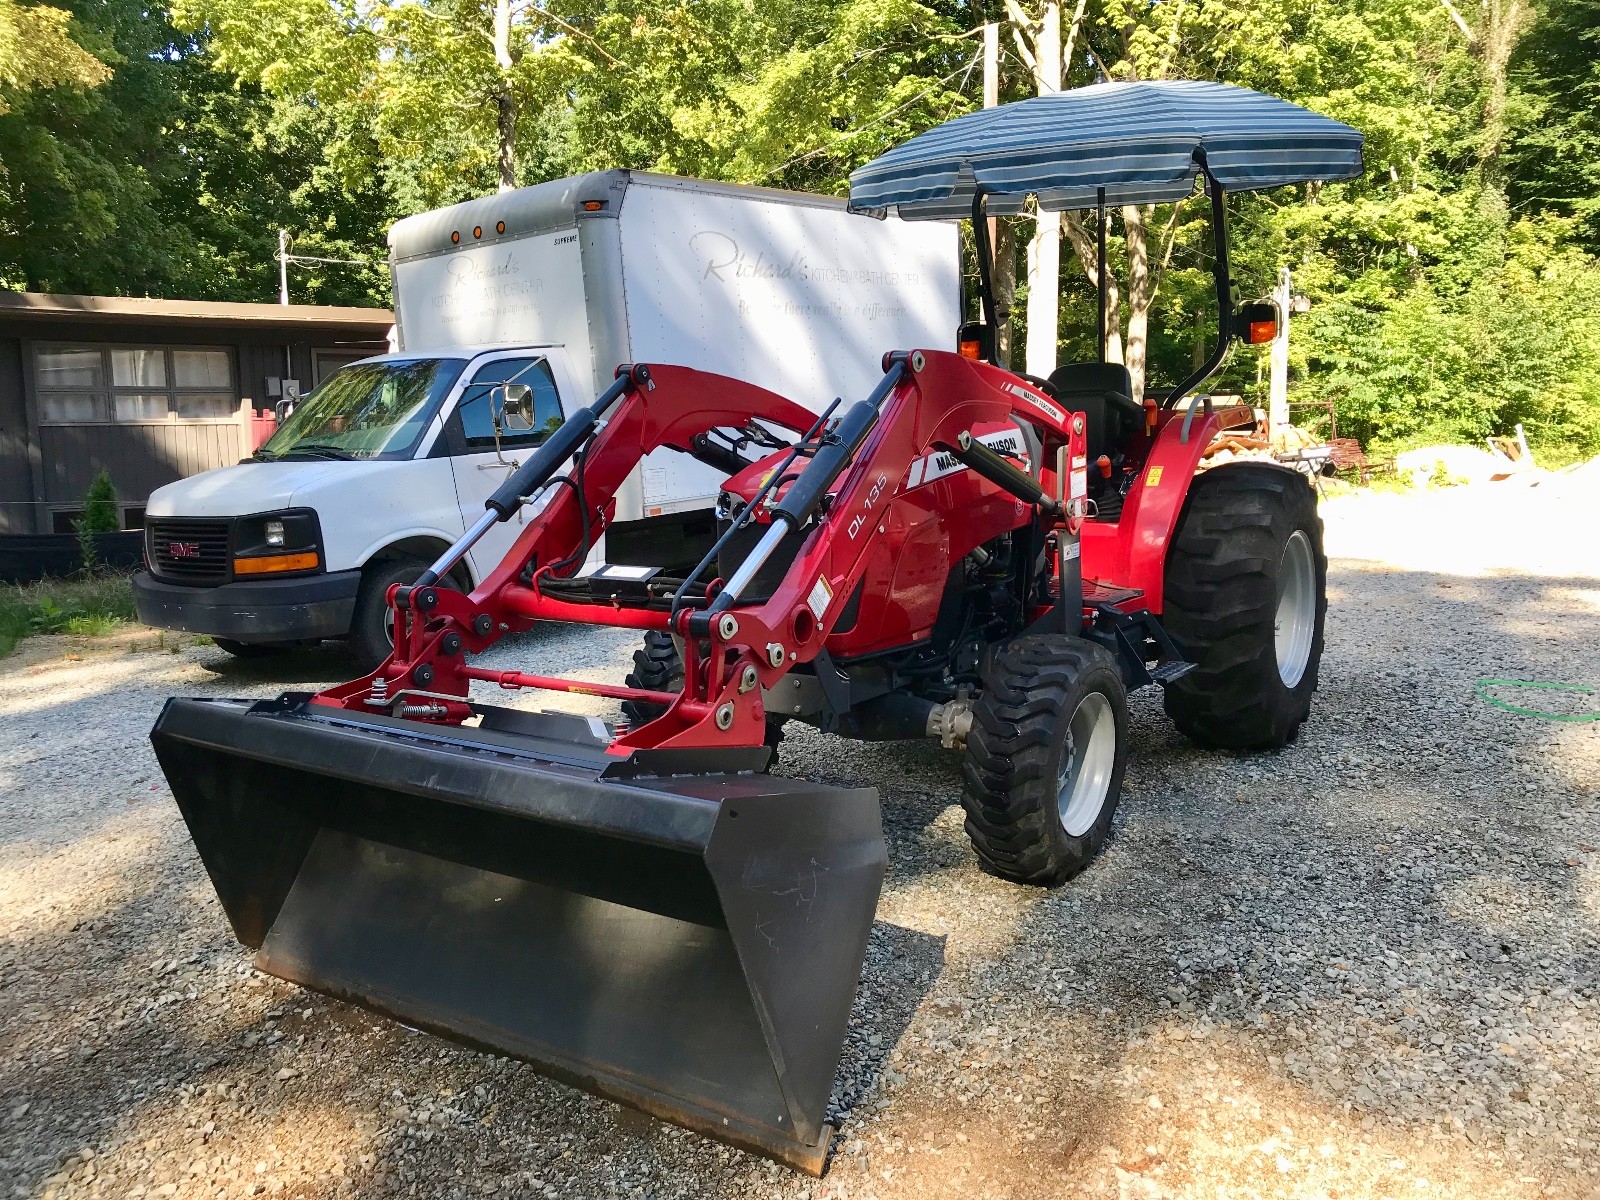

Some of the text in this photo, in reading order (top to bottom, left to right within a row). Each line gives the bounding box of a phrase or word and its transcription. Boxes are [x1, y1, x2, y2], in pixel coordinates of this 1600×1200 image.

[553, 234, 578, 246] SUPREME
[688, 230, 808, 283] Richard's
[884, 271, 919, 286] CENTER
[446, 250, 520, 287] Richard's
[847, 472, 888, 540] DL 135
[169, 542, 200, 558] GMC
